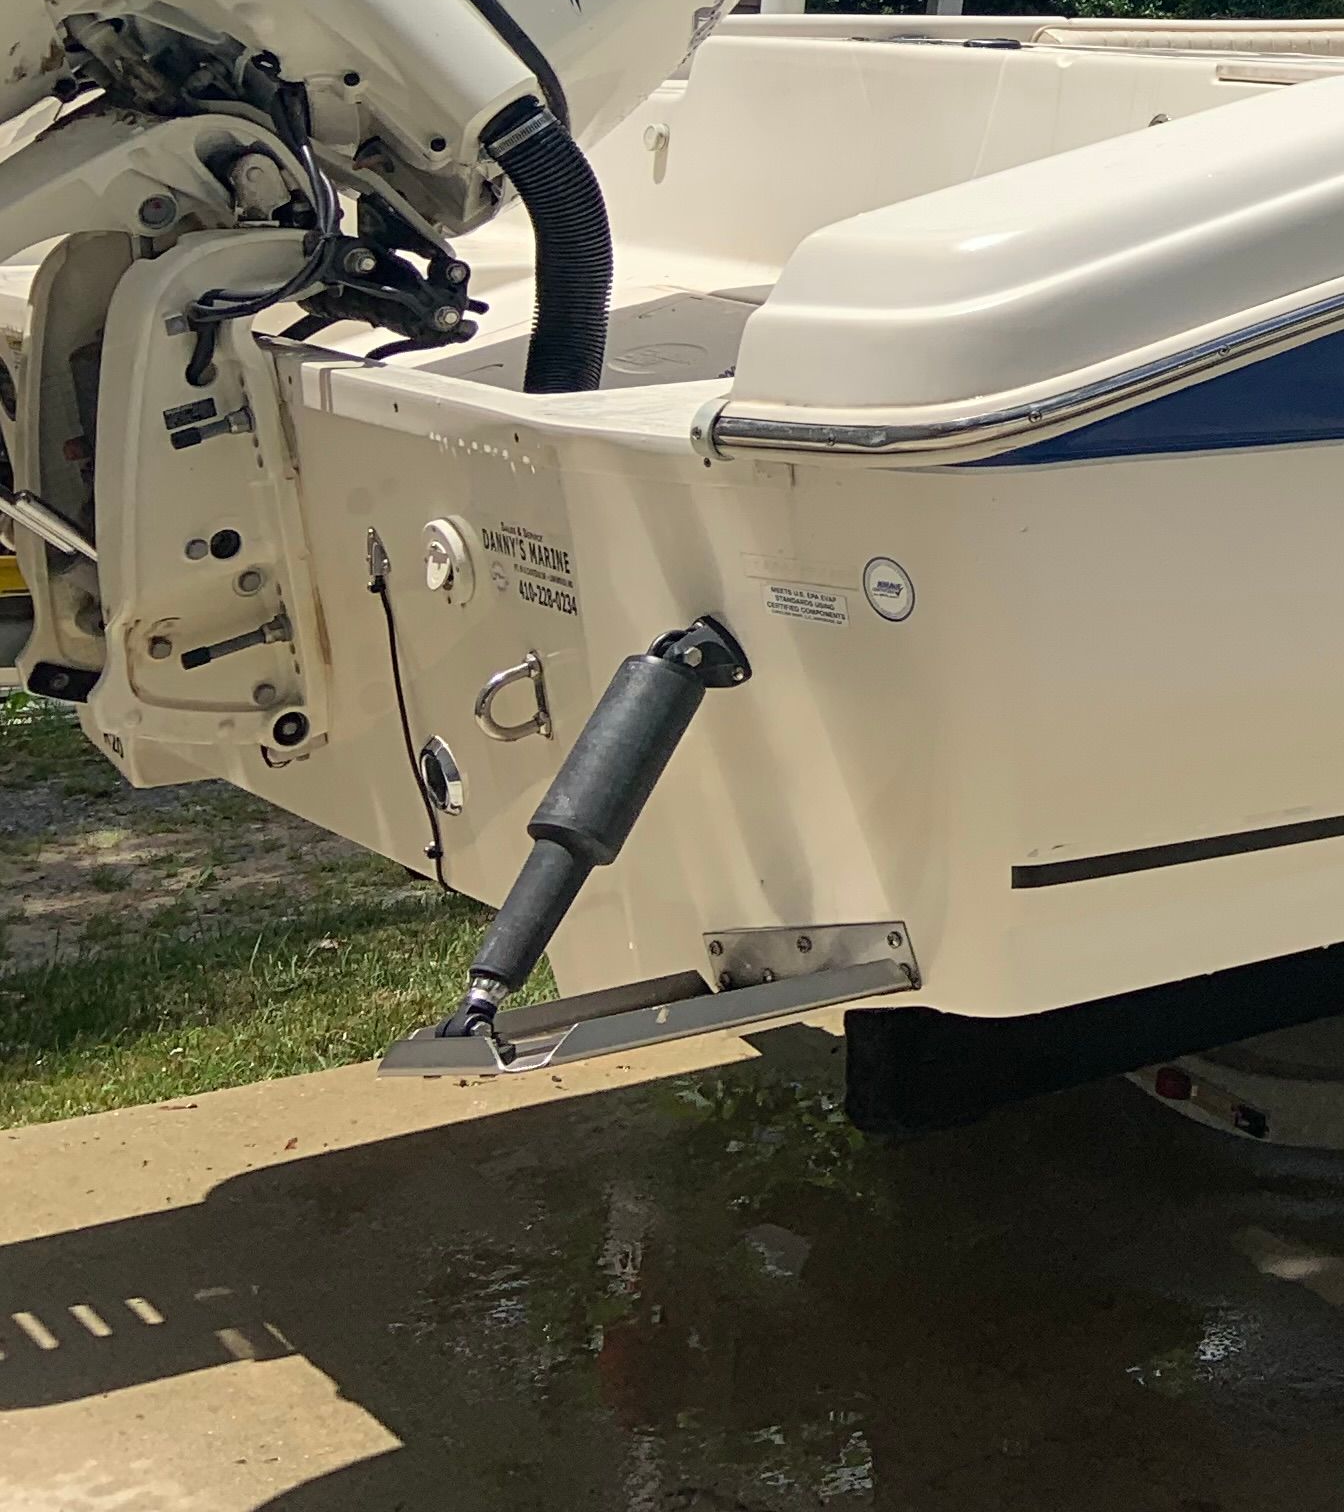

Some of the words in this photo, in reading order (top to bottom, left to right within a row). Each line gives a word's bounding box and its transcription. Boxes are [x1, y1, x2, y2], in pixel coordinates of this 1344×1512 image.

[481, 528, 527, 561] DANNY'S
[528, 541, 571, 574] MARINE
[770, 586, 792, 596] MEETS
